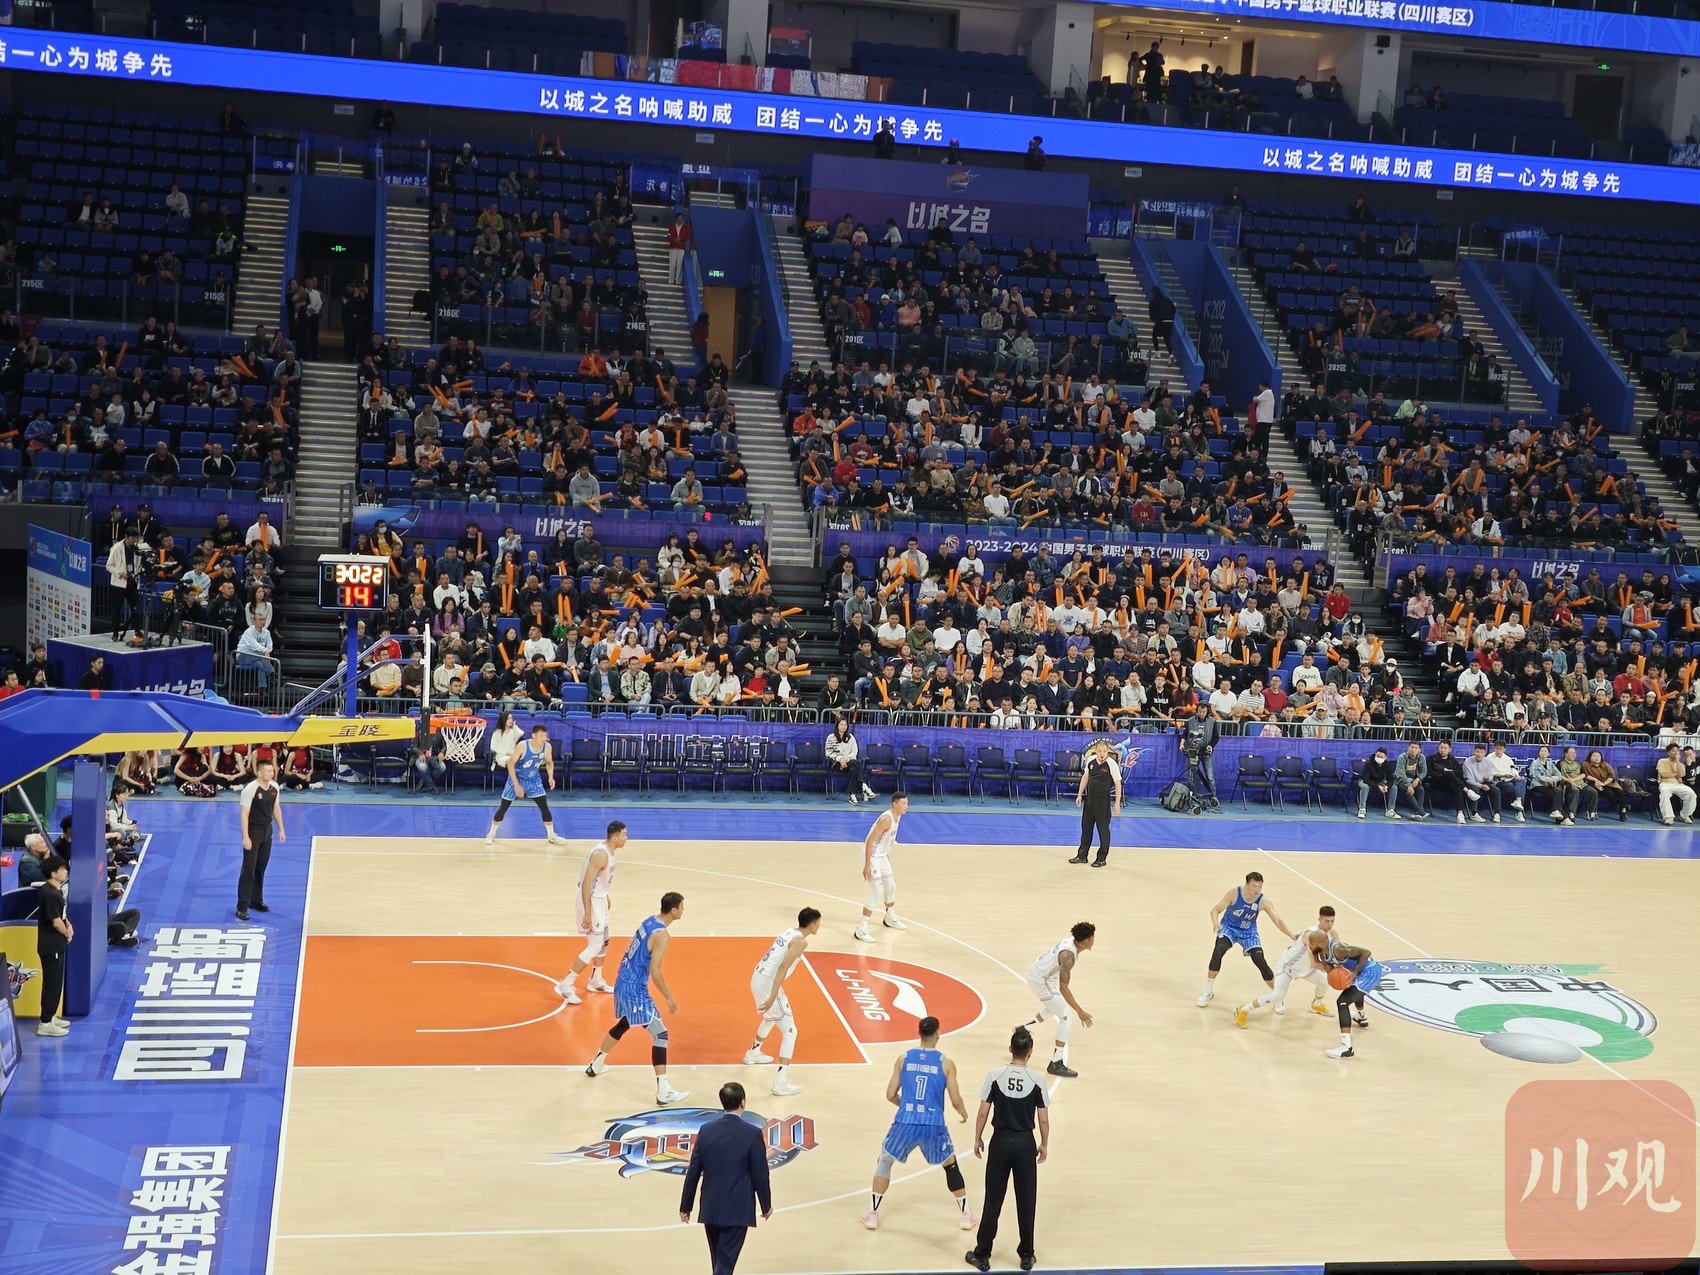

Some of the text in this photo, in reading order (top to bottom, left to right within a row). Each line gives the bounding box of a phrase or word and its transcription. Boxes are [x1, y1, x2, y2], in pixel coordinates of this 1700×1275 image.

[539, 88, 733, 125] 以城之名呐喊助威
[1262, 147, 1621, 194] 以城之名呐喊助威 团结一心为城争先
[907, 202, 991, 234] 以城之名
[438, 308, 460, 318] 216区
[626, 322, 646, 331] 216区
[844, 335, 864, 344] 201区
[345, 586, 369, 607] 14
[113, 927, 267, 1081] 四川蓝鲸
[835, 968, 891, 1022] LI-NING
[915, 1075, 928, 1100] 1
[1007, 1077, 1024, 1092] 55
[111, 1144, 232, 1275] 金强集团
